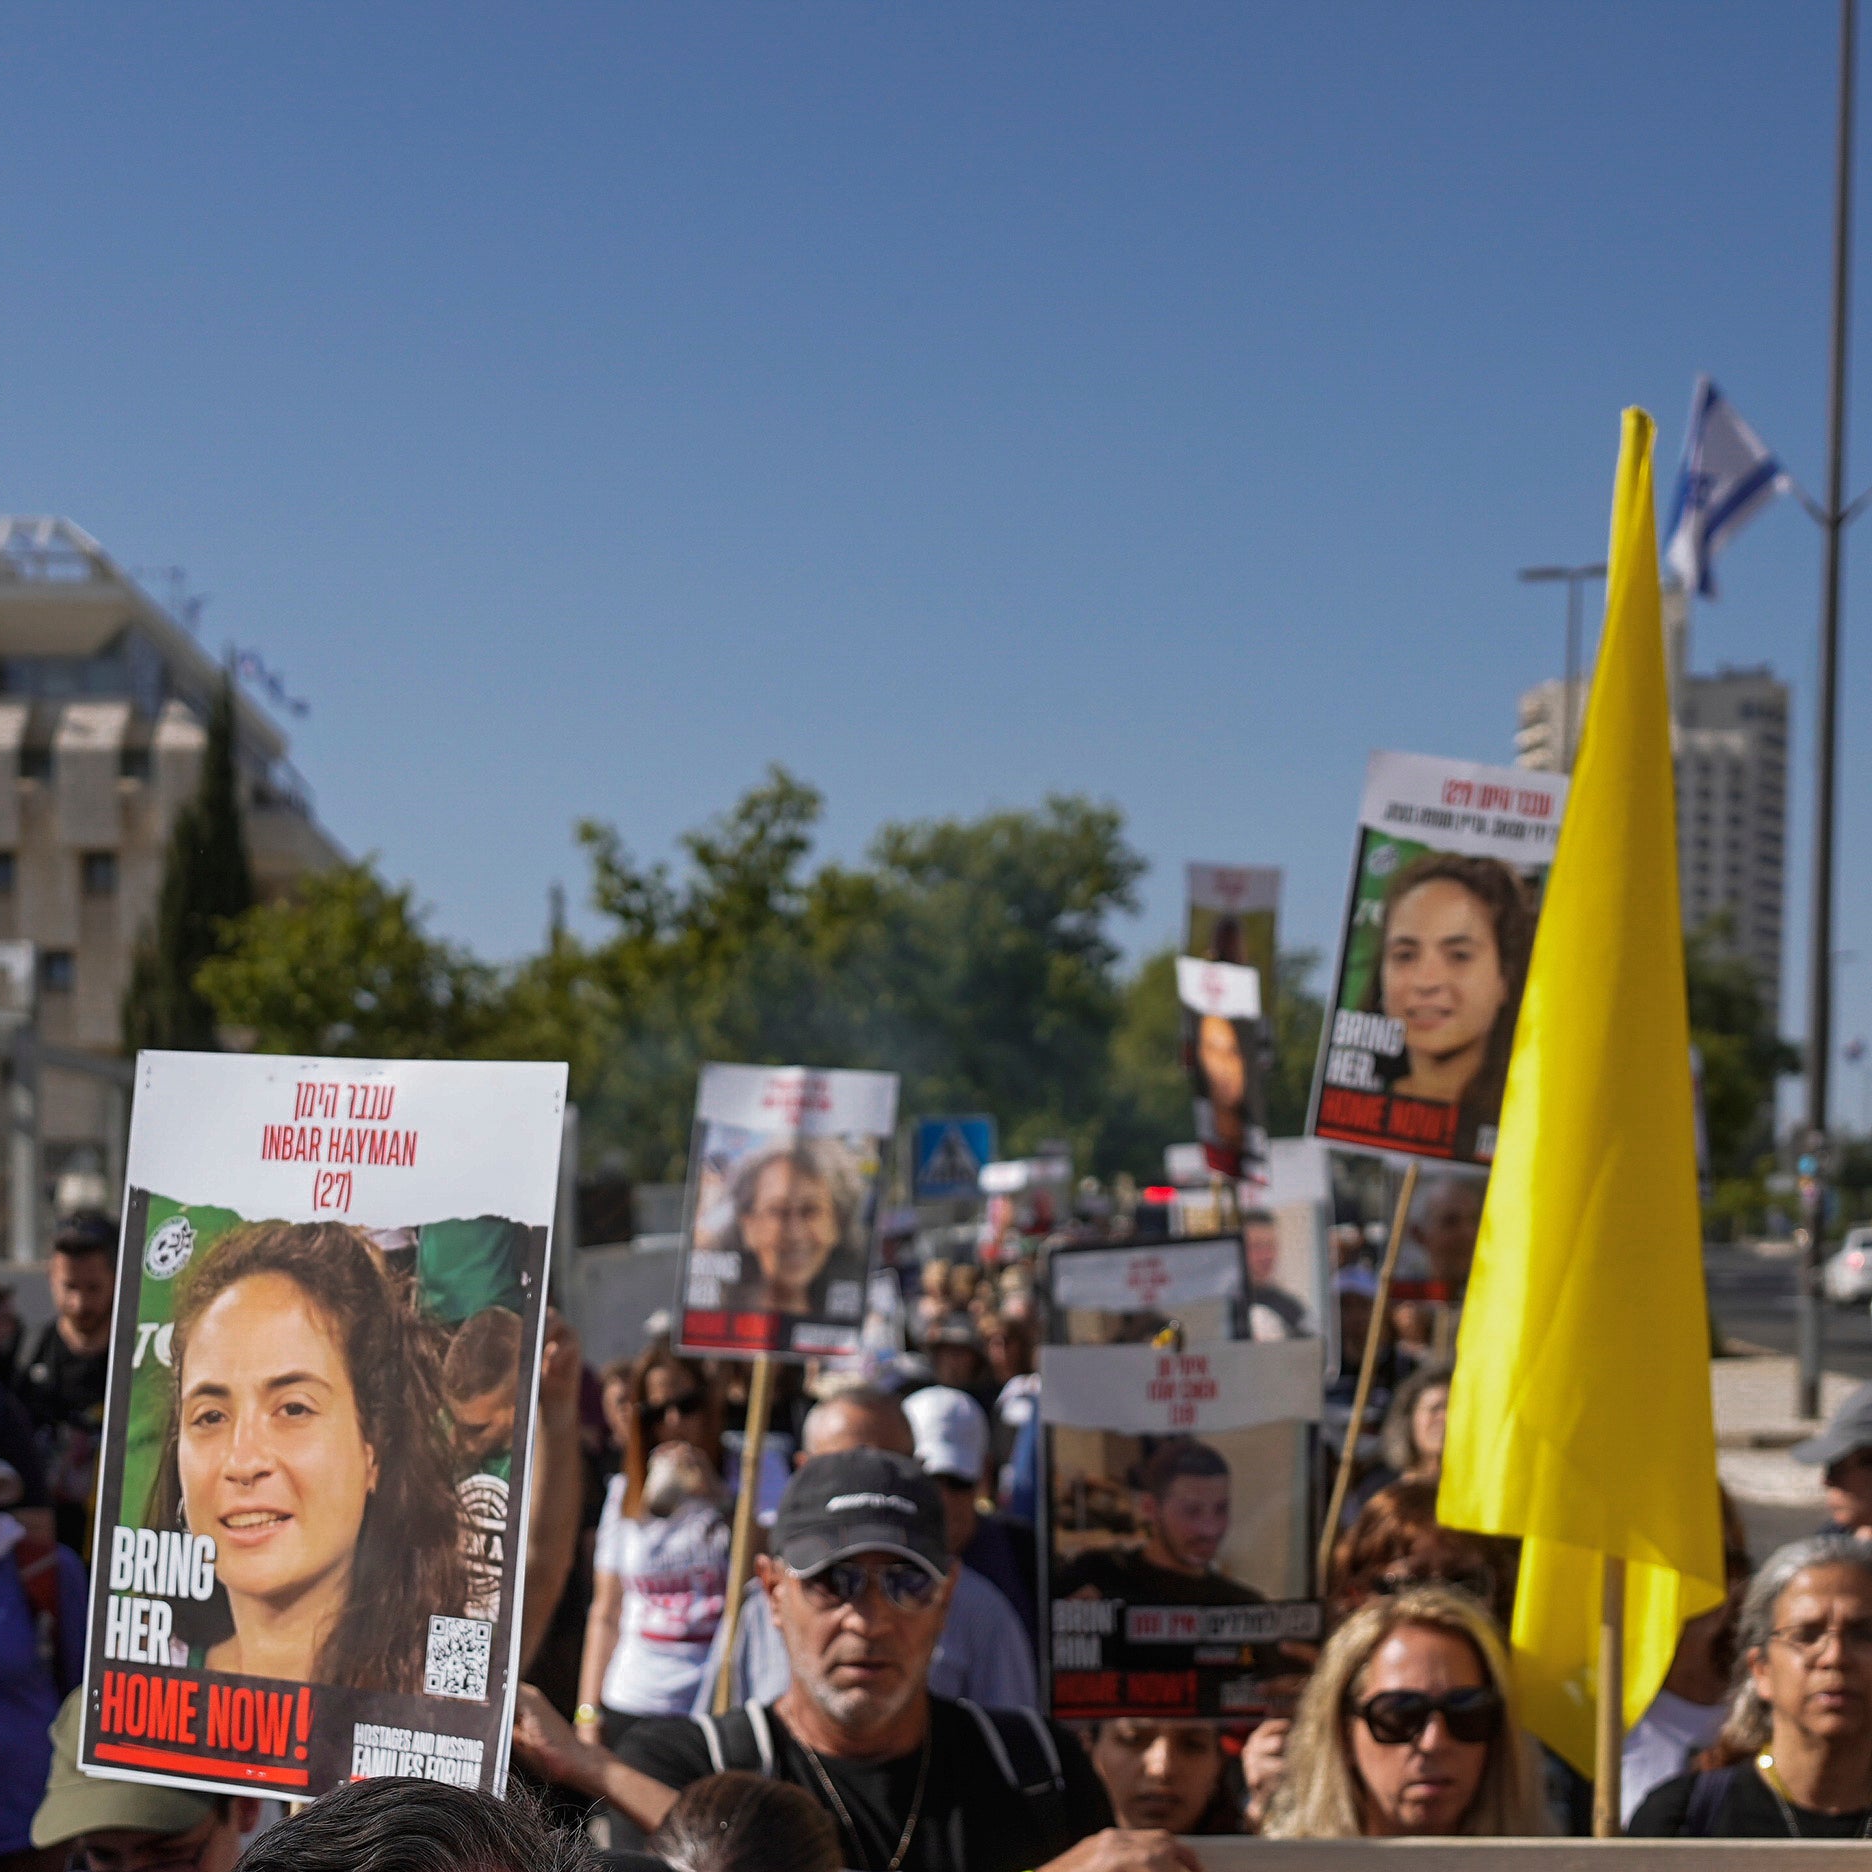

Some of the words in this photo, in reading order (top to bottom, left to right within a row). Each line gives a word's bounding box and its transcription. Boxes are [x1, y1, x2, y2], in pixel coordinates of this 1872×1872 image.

[294, 1080, 342, 1122] הימן
[347, 1082, 397, 1122] ענבר
[262, 1124, 323, 1162] INBAR
[328, 1127, 419, 1168] HAYMAN
[313, 1169, 353, 1213] (27)
[109, 1525, 216, 1602] BRING
[104, 1594, 173, 1667] HER
[100, 1670, 200, 1745] HOME
[206, 1684, 312, 1761] NOW!
